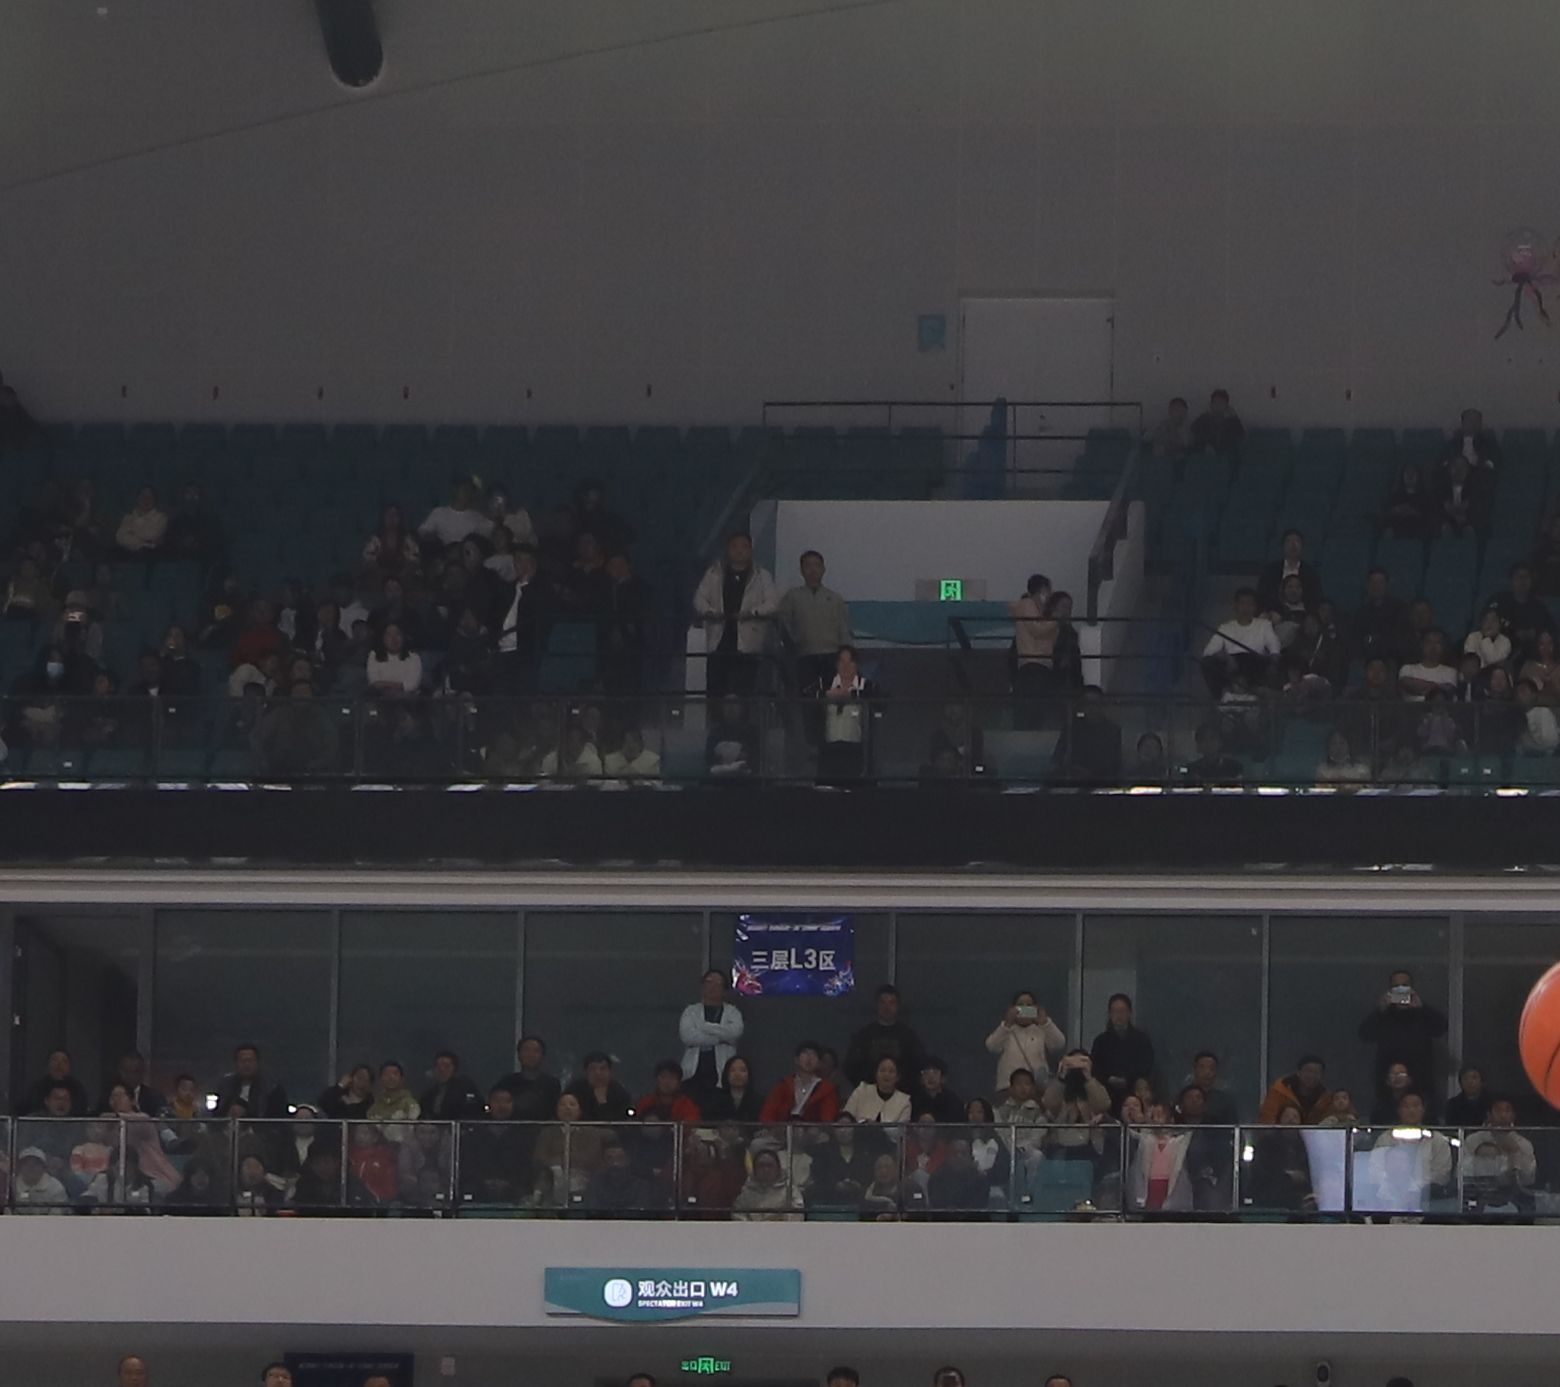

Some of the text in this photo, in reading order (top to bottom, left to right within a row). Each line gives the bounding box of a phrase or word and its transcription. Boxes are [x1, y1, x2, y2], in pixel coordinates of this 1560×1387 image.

[750, 949, 837, 971] 三层L3区
[638, 1281, 738, 1298] 观众出口 W4
